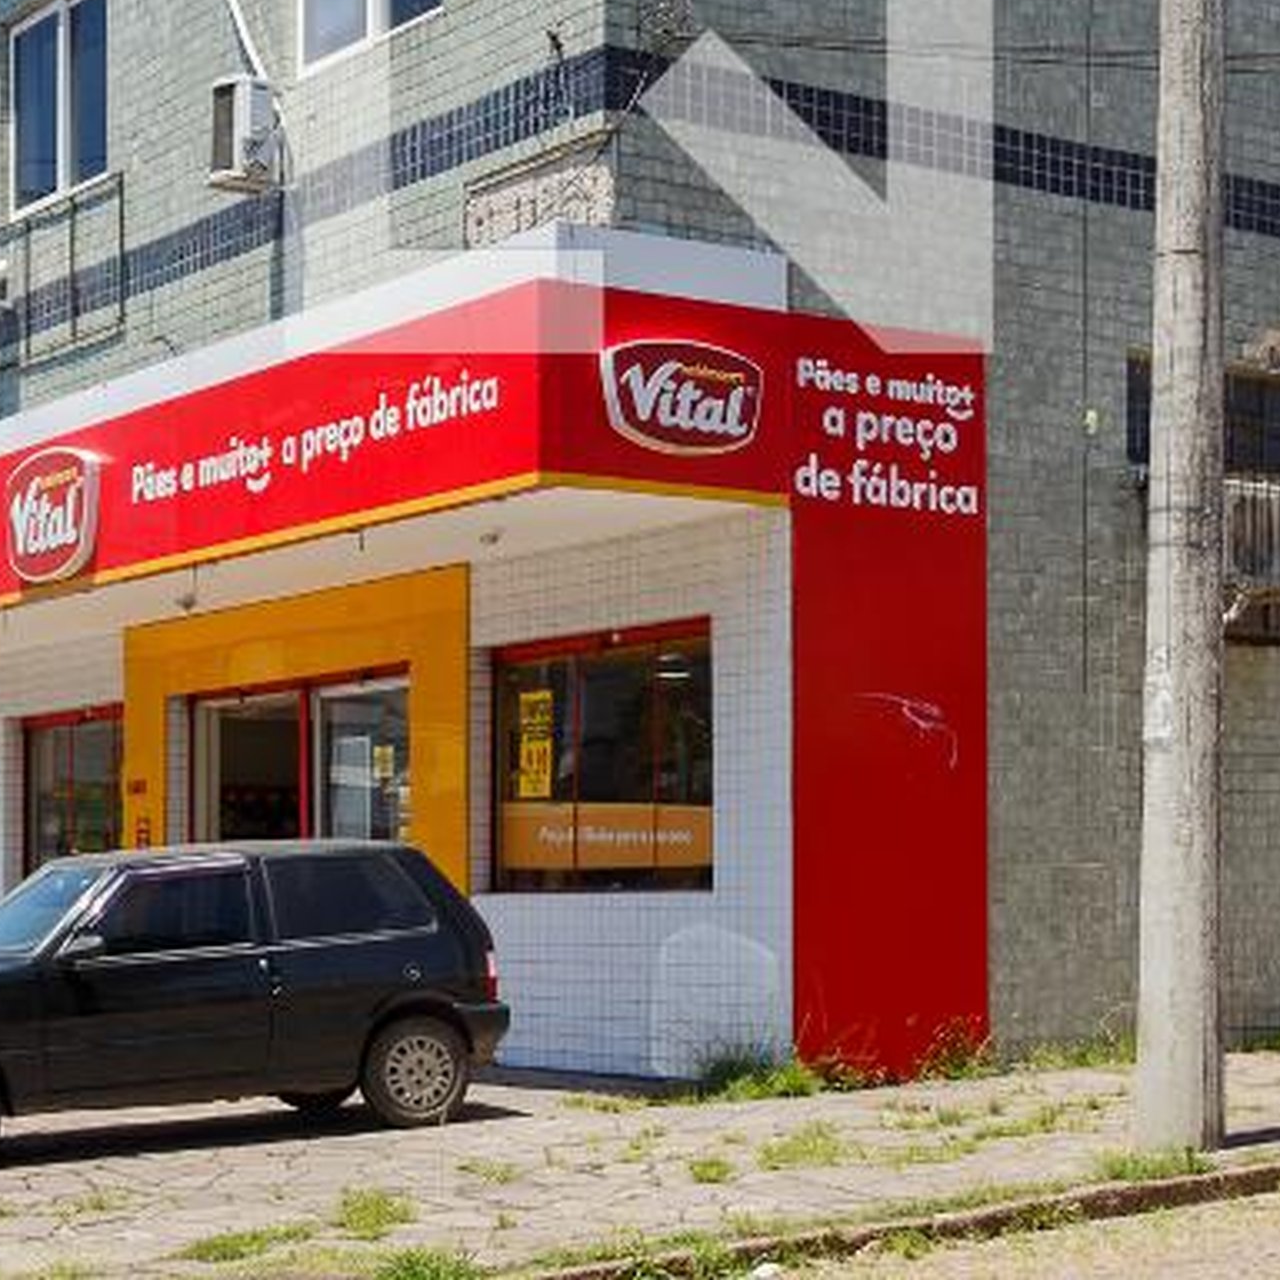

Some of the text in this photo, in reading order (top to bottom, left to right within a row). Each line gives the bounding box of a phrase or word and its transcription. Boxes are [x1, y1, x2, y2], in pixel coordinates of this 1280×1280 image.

[619, 361, 748, 437] Vital
[797, 357, 860, 394] Pães
[865, 374, 881, 396] e
[131, 463, 177, 504] Pães
[181, 463, 195, 492] e
[282, 437, 296, 466] a
[301, 415, 364, 472] preço
[370, 392, 400, 441] de
[405, 371, 500, 431] fábrica
[822, 406, 958, 461] a preço
[11, 476, 80, 556] Vital
[795, 452, 979, 515] de fábrica
